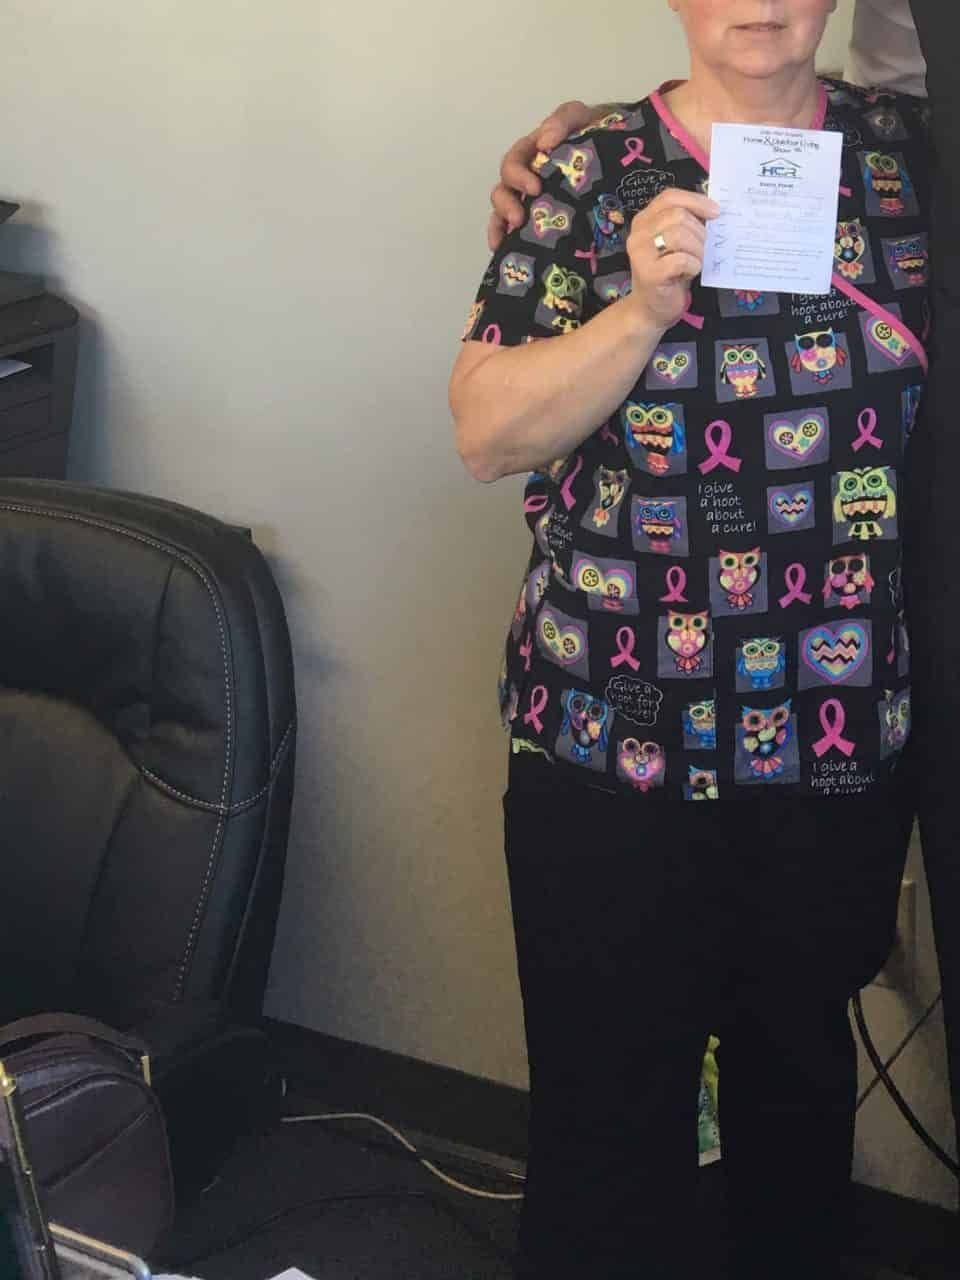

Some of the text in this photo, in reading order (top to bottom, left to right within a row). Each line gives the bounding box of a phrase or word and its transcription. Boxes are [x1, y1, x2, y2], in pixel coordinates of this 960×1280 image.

[791, 297, 857, 316] hoot about
[804, 309, 848, 324] a cure!
[698, 481, 734, 498] I give
[700, 495, 743, 508] a hoot
[706, 508, 745, 521] about
[711, 521, 757, 533] a cure!
[813, 760, 857, 776] I give a
[811, 772, 876, 787] hoot about
